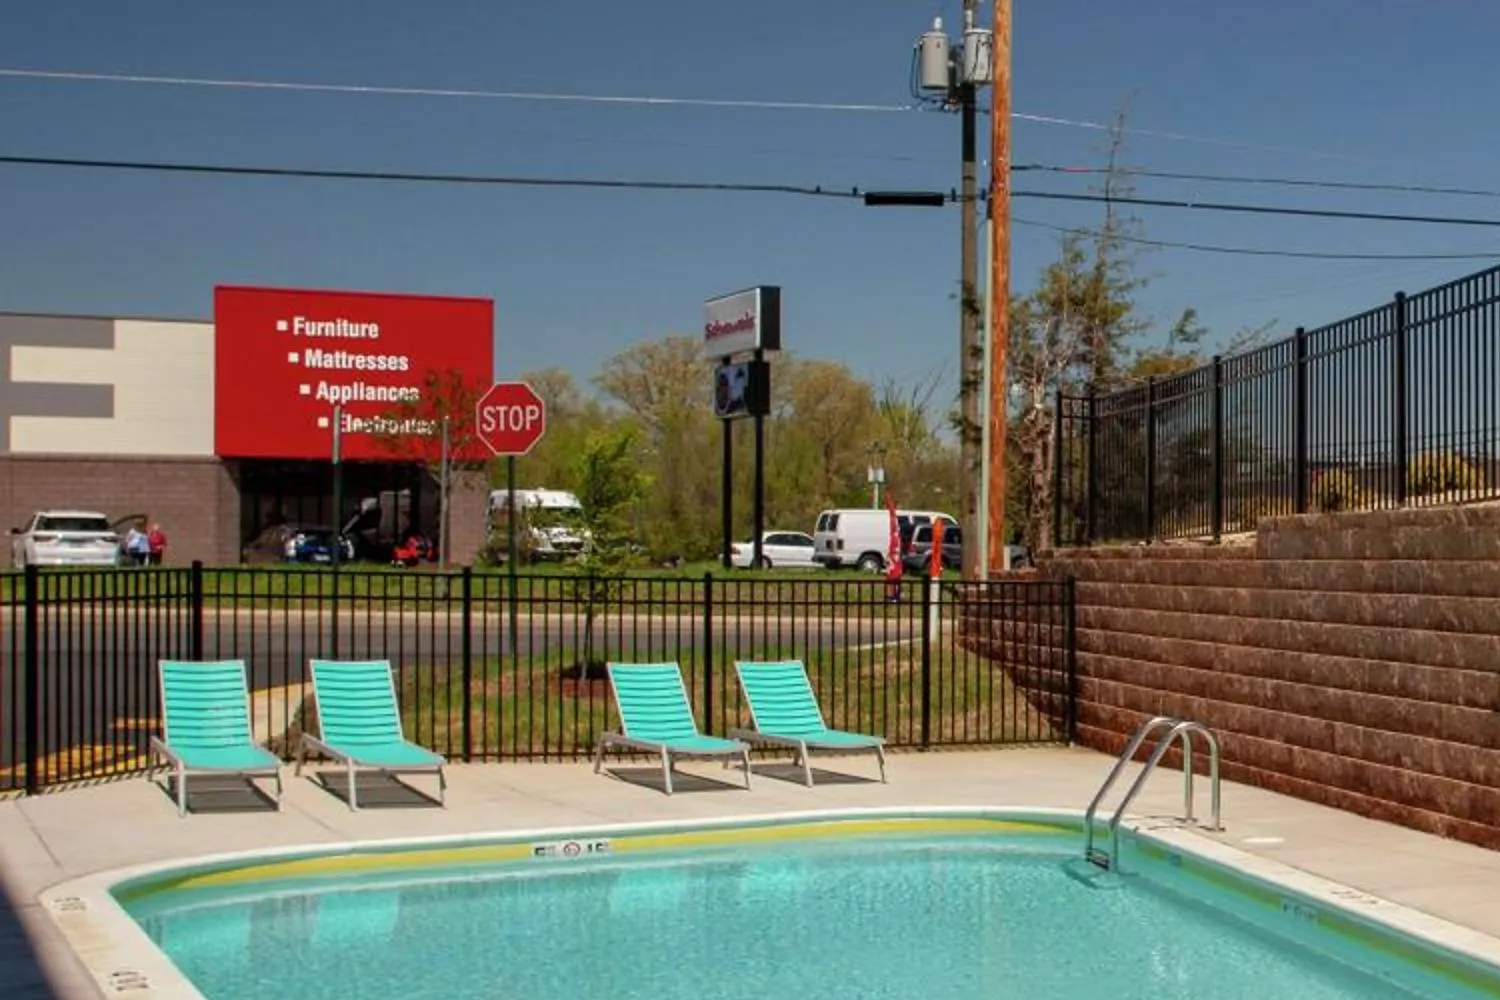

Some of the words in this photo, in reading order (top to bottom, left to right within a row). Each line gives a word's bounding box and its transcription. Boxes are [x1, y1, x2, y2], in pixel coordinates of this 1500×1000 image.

[293, 317, 379, 339] Furniture
[304, 349, 409, 371] Mattresses
[316, 381, 419, 404] Appliances
[482, 405, 540, 432] STOP
